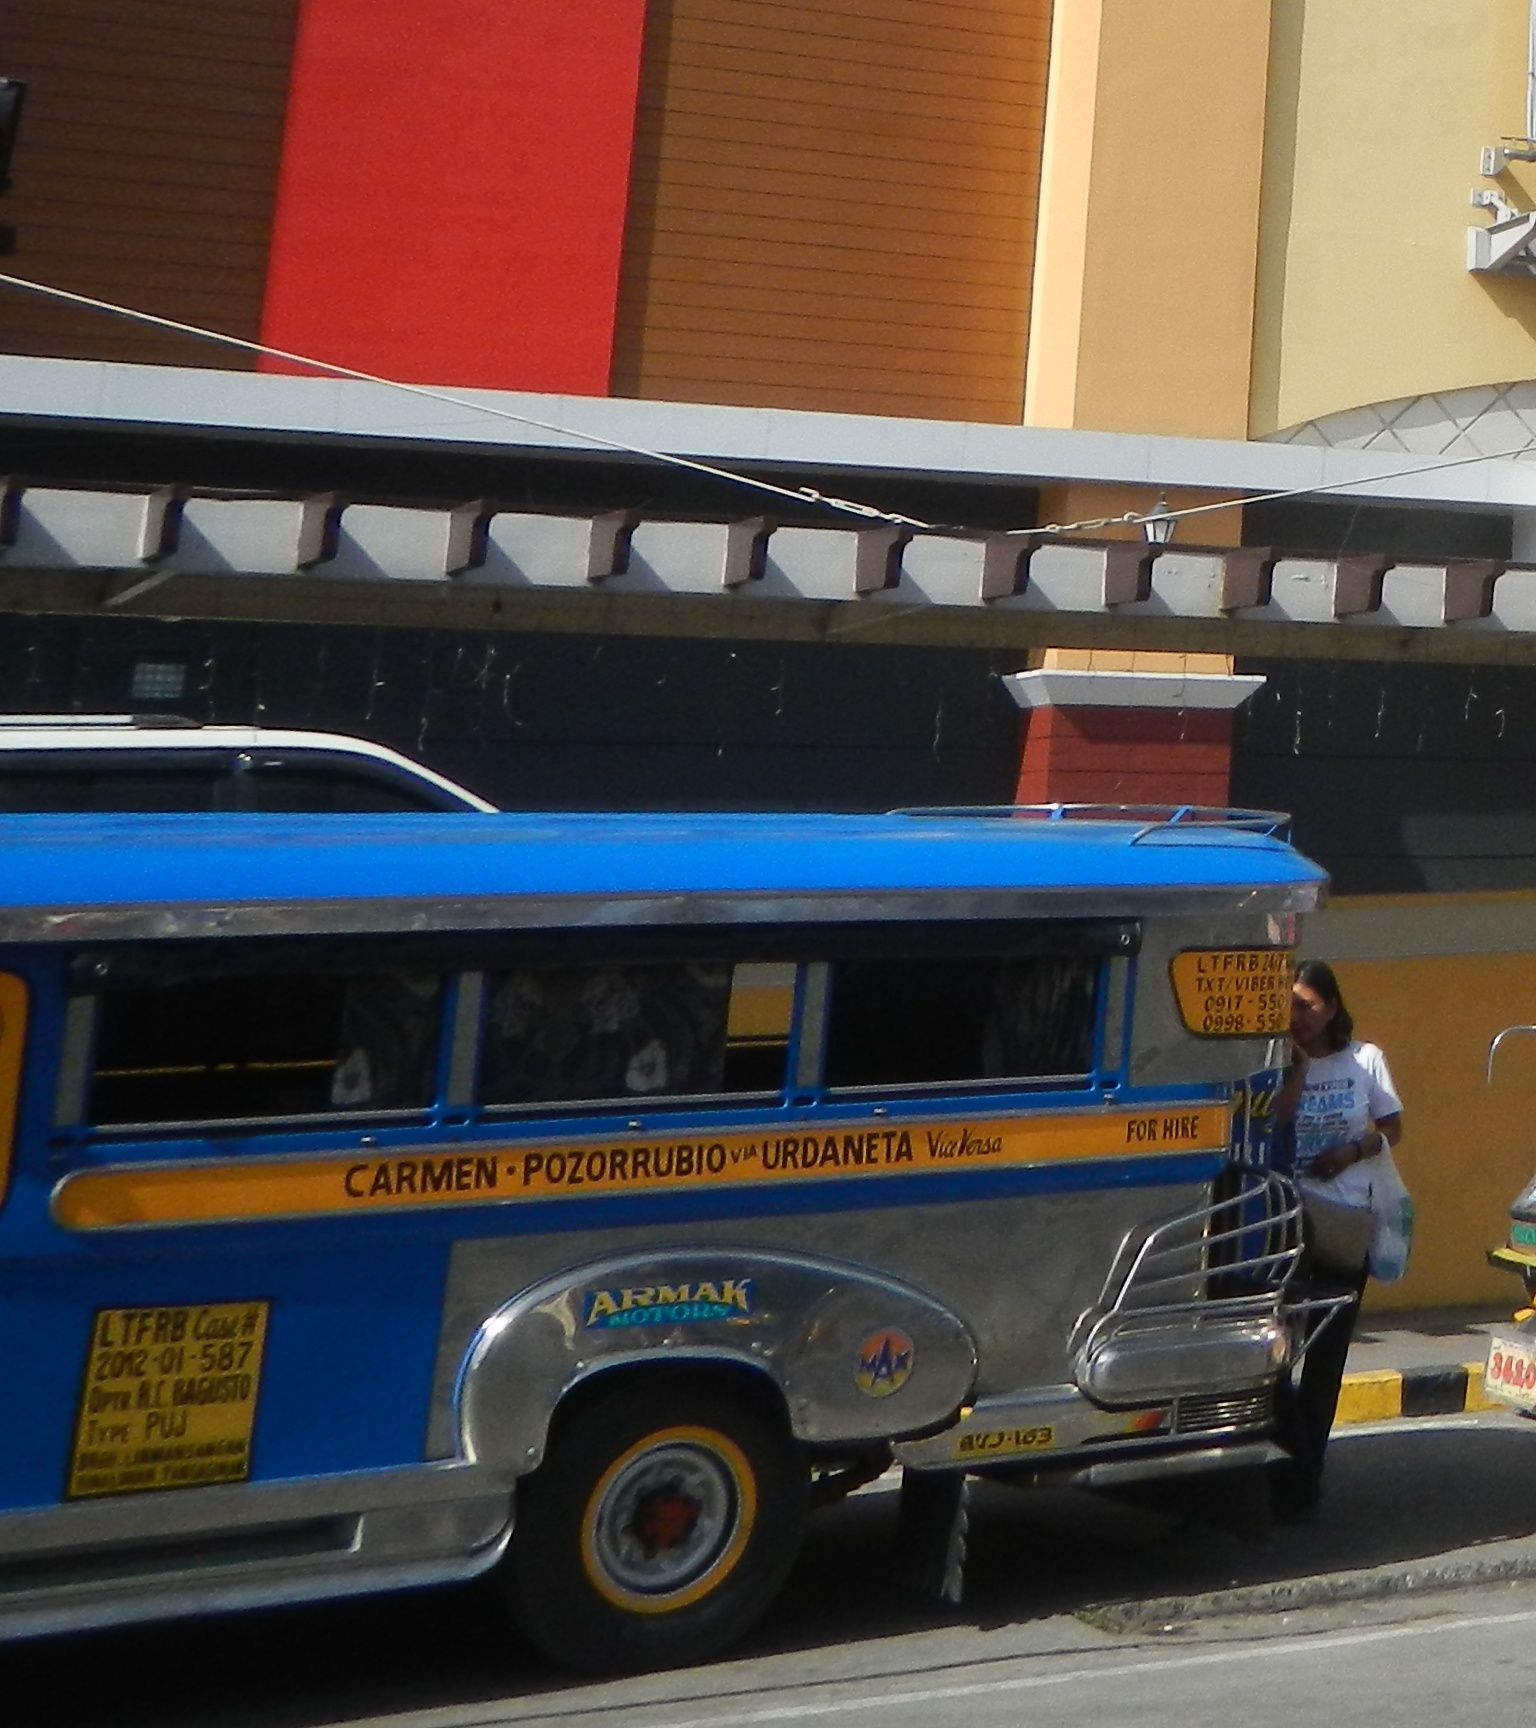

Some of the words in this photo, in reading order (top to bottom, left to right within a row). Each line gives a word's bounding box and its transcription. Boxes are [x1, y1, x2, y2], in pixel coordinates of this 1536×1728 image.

[1197, 954, 1258, 973] LTFRB
[345, 1155, 498, 1197] CARMEN
[522, 1143, 726, 1186] POZORRUBIO
[731, 1144, 757, 1165] VIA
[762, 1129, 914, 1170] URDANETA
[1126, 1118, 1157, 1143] FOR
[1162, 1115, 1200, 1141] HIRE
[585, 1279, 751, 1327] ARMAK
[145, 1410, 187, 1439] PUJ
